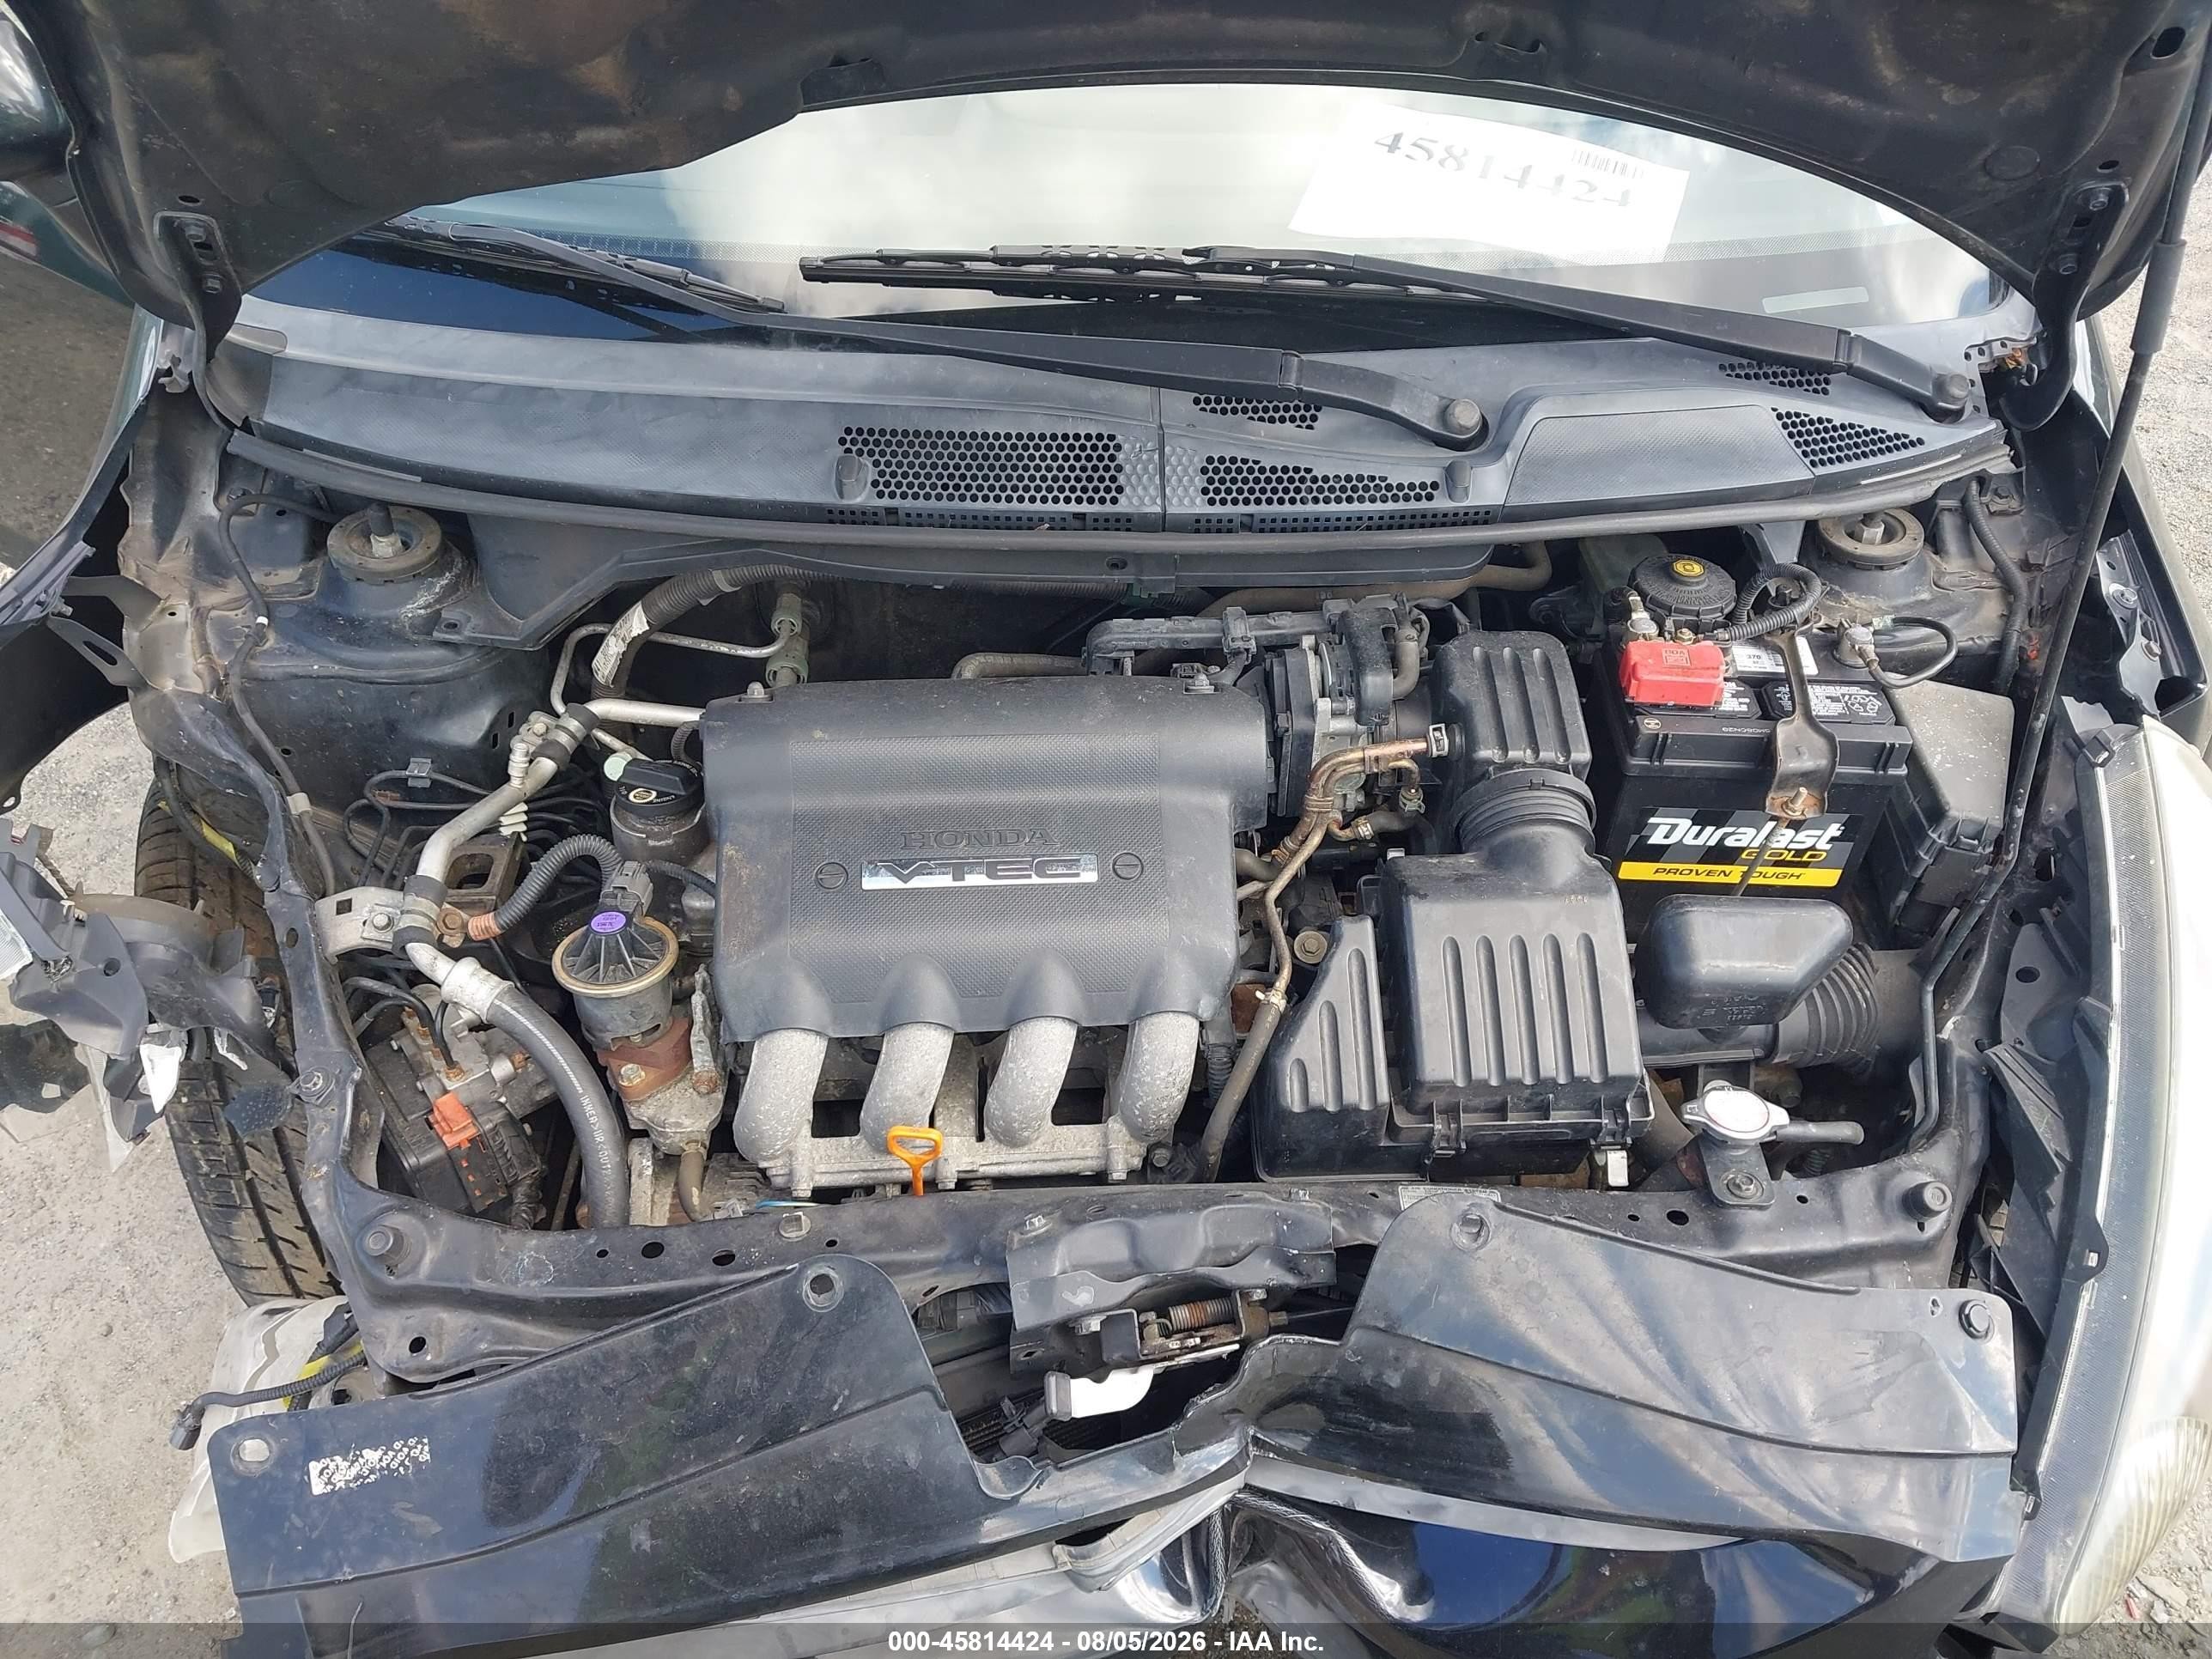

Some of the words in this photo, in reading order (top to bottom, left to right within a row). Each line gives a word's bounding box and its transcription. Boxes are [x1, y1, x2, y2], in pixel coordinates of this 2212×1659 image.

[901, 828, 1060, 850] HONDA
[1647, 817, 1843, 850] Duralast
[1741, 849, 1827, 861] GOLD
[877, 857, 1082, 884] VTEC
[1653, 867, 1733, 878] PROVEN
